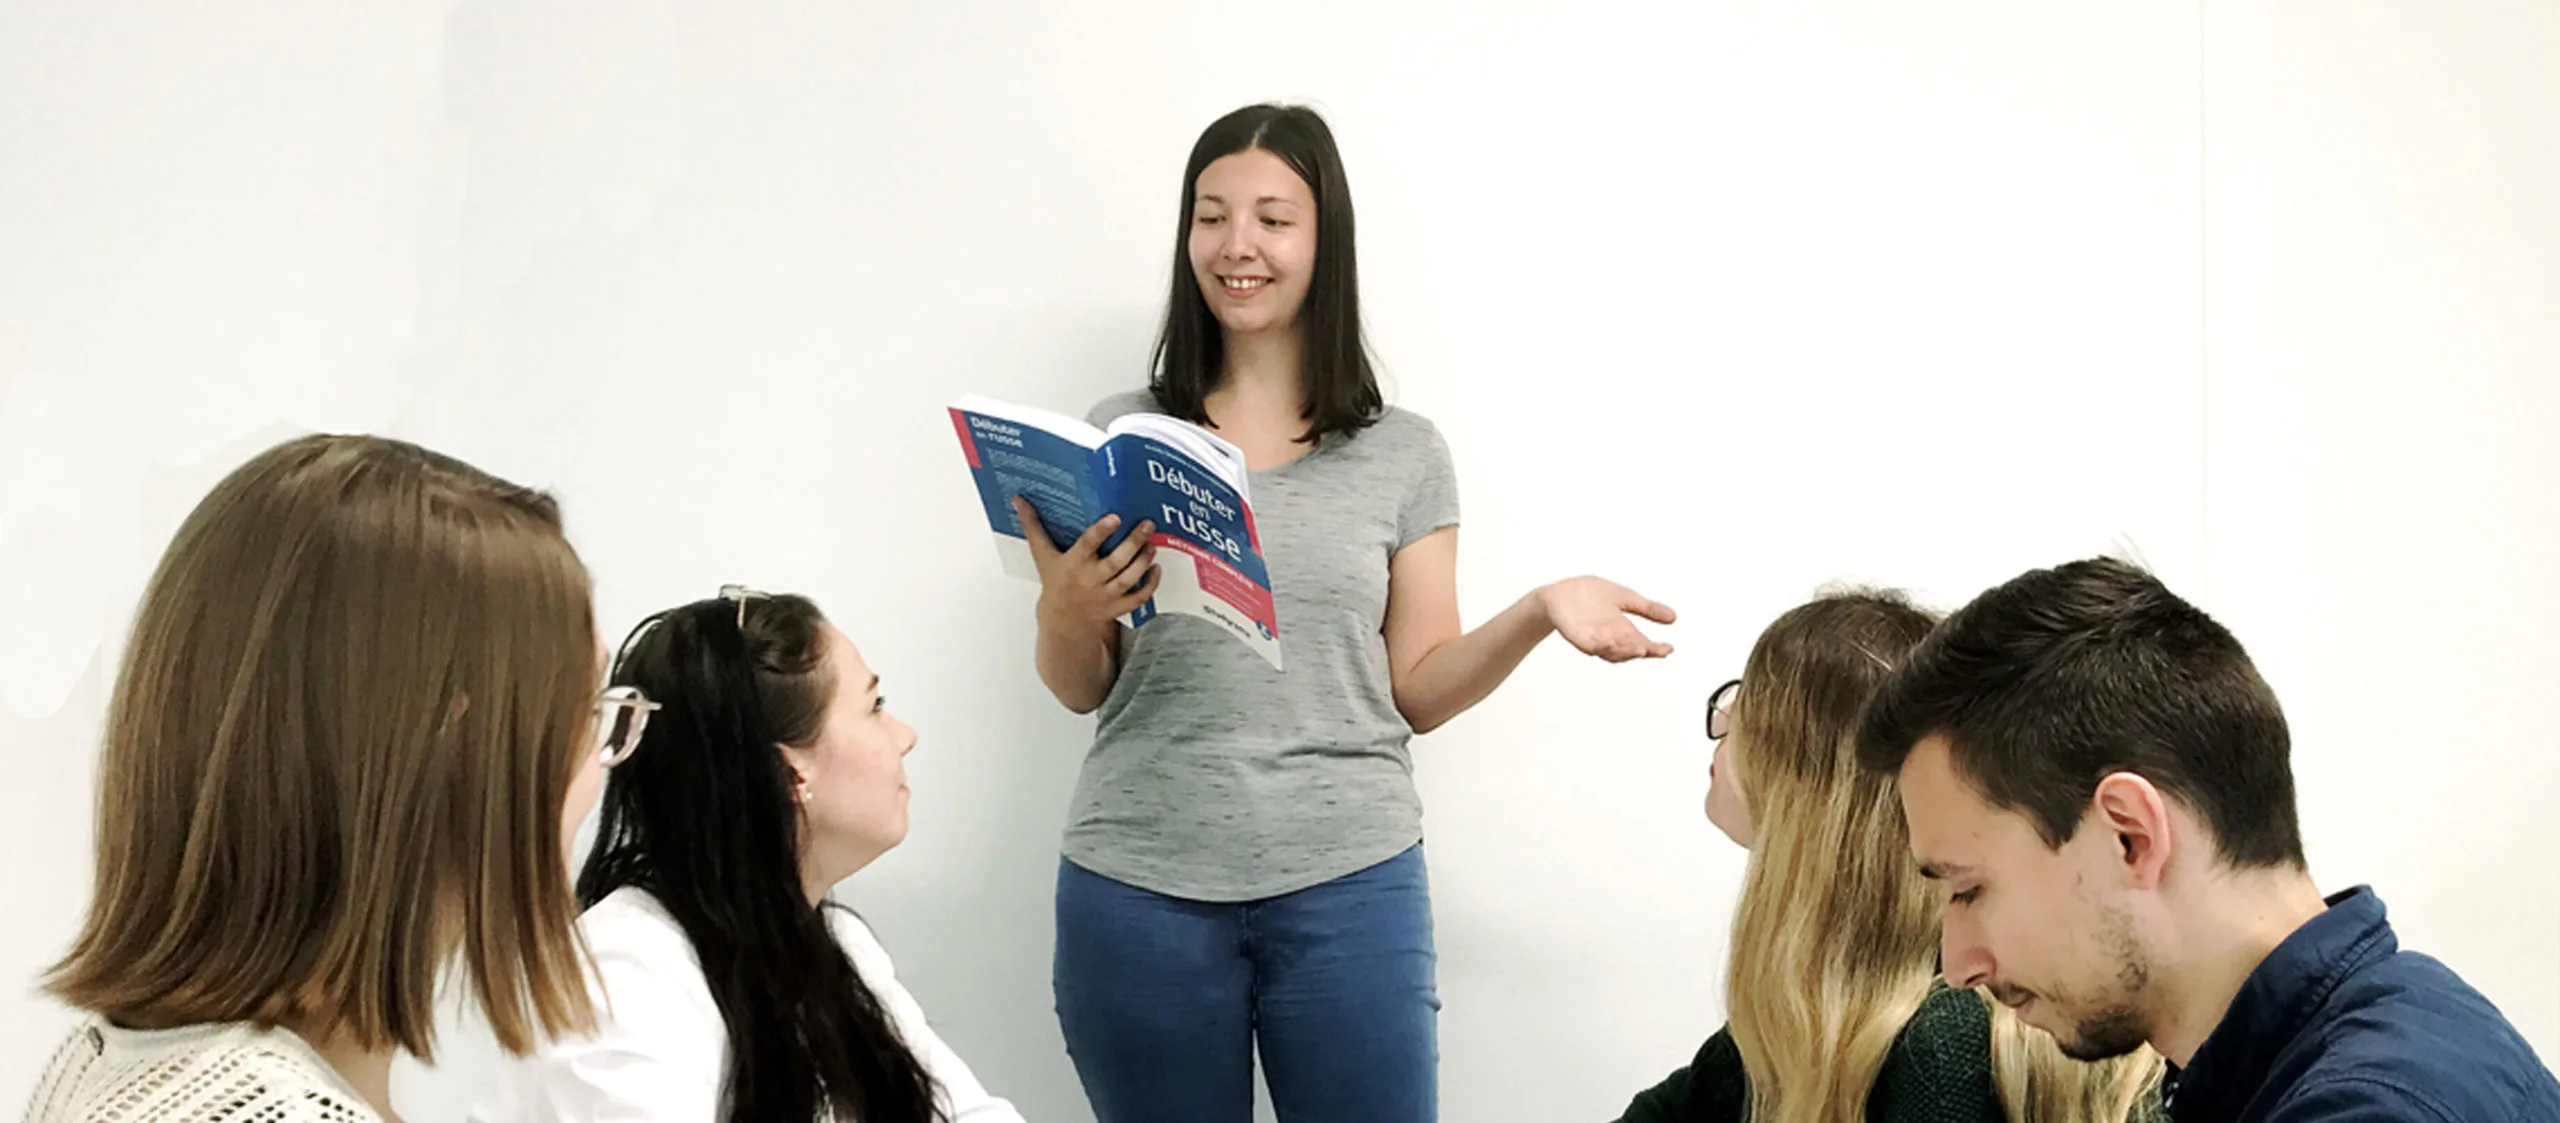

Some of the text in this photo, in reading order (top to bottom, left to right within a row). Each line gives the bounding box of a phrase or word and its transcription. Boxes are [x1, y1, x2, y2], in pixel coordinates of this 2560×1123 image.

[1147, 459, 1236, 521] Débuter
[1189, 501, 1211, 520] en
[1161, 503, 1242, 562] russe
